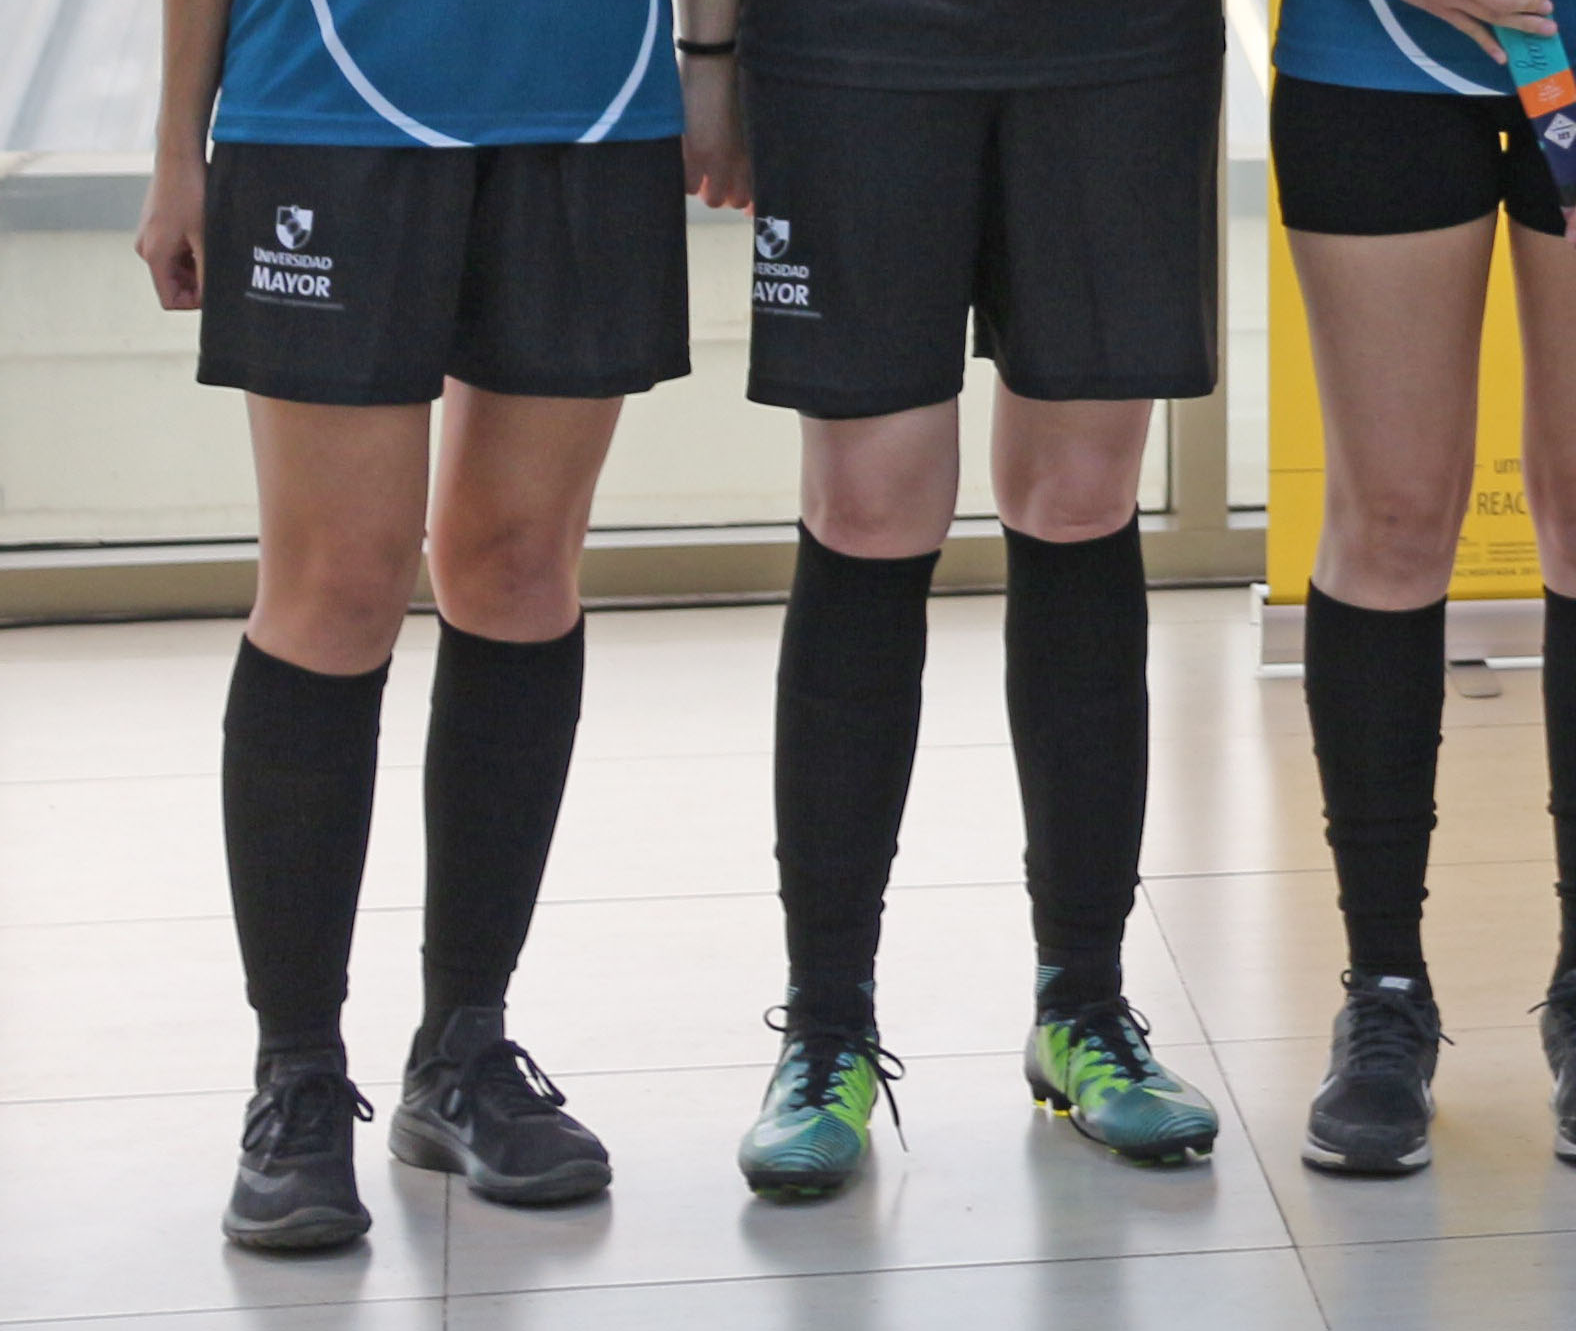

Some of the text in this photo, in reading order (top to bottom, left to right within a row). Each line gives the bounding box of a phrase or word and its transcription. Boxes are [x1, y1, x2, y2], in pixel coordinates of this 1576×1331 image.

[253, 245, 333, 271] UNIVERSIDAD
[251, 264, 331, 298] MAYOR
[752, 280, 810, 306] AYOR
